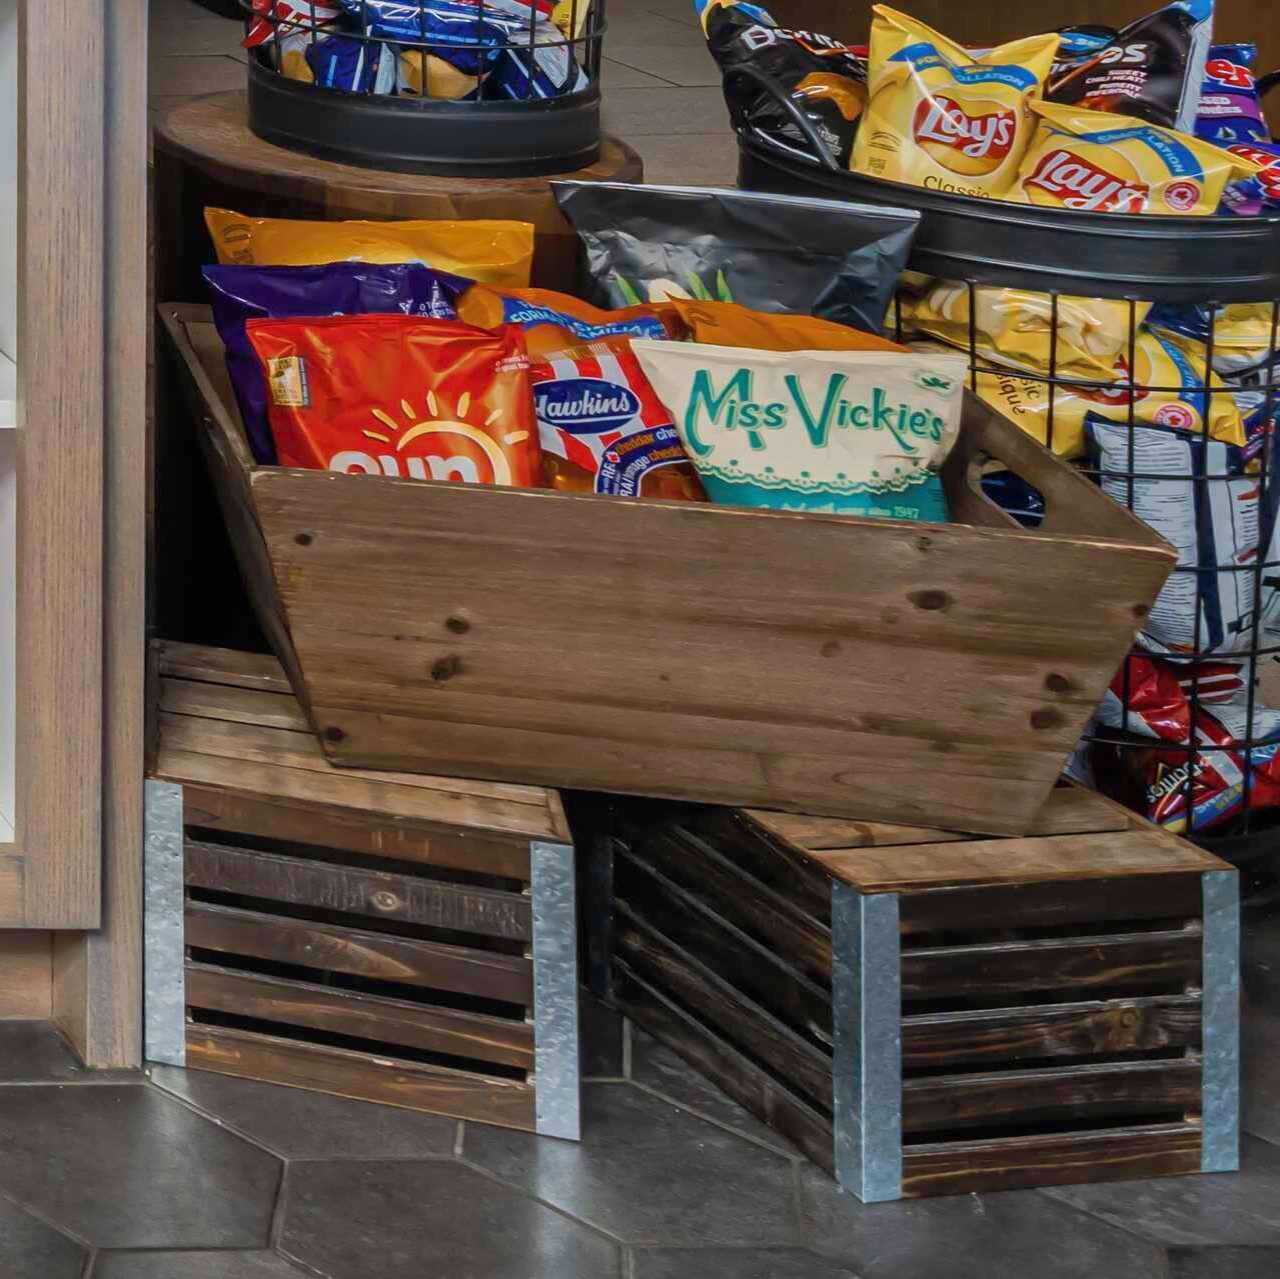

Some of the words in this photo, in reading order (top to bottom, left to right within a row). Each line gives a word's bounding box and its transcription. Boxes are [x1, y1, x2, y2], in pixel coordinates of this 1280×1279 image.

[917, 97, 1014, 157] Lay's
[1033, 152, 1149, 212] Lay's
[535, 389, 632, 418] Hawkins
[688, 368, 787, 458] Miss
[784, 373, 945, 453] Vickie's
[616, 435, 654, 456] cheddar
